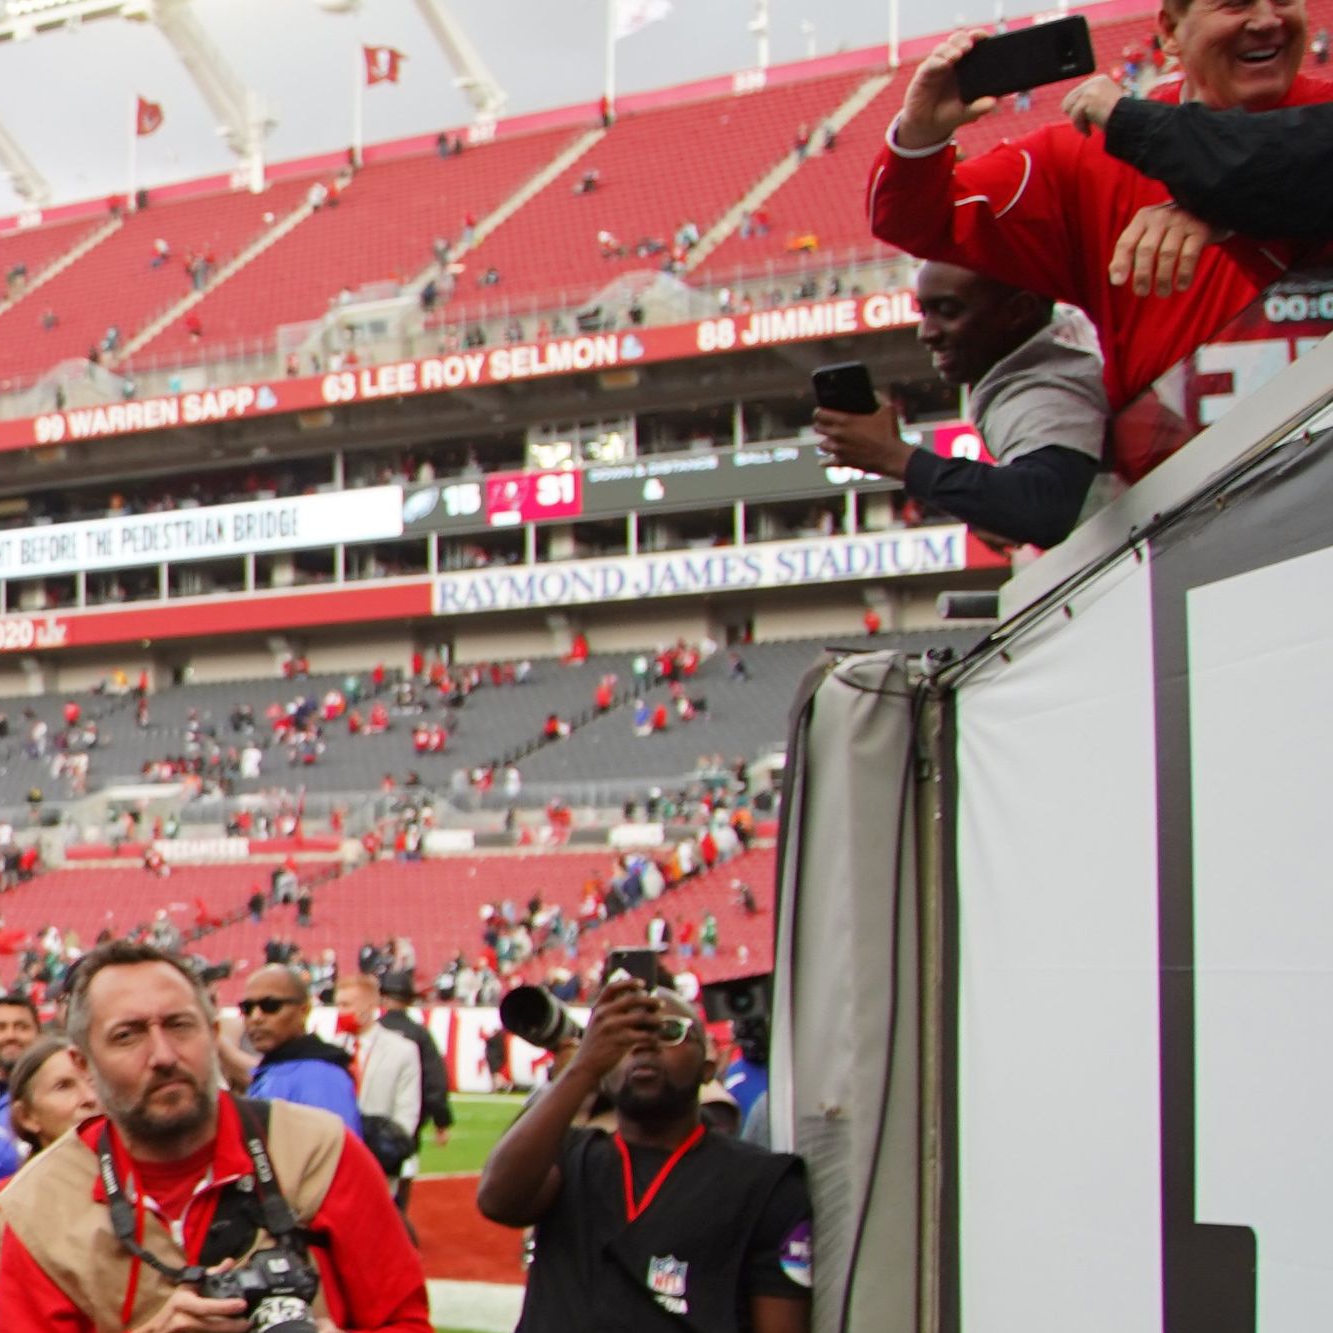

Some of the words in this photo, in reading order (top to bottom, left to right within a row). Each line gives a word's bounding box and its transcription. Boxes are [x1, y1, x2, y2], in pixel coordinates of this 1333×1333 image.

[696, 317, 736, 352] 88
[741, 299, 858, 346] JIMMIE
[321, 372, 357, 403] 63
[359, 361, 418, 399] LEE
[420, 350, 485, 390] ROY
[488, 333, 619, 381] SELMON
[34, 413, 66, 444] 99
[68, 397, 179, 438] WARREN
[182, 386, 255, 423] SAPP
[19, 534, 78, 567] BEFORE
[85, 528, 113, 558] THE
[121, 515, 227, 555] PEDESTRIAN
[233, 506, 301, 543] BRIDGE
[439, 563, 628, 612] RAYMOND
[633, 552, 763, 598] JAMES
[775, 534, 957, 582] STADIUM
